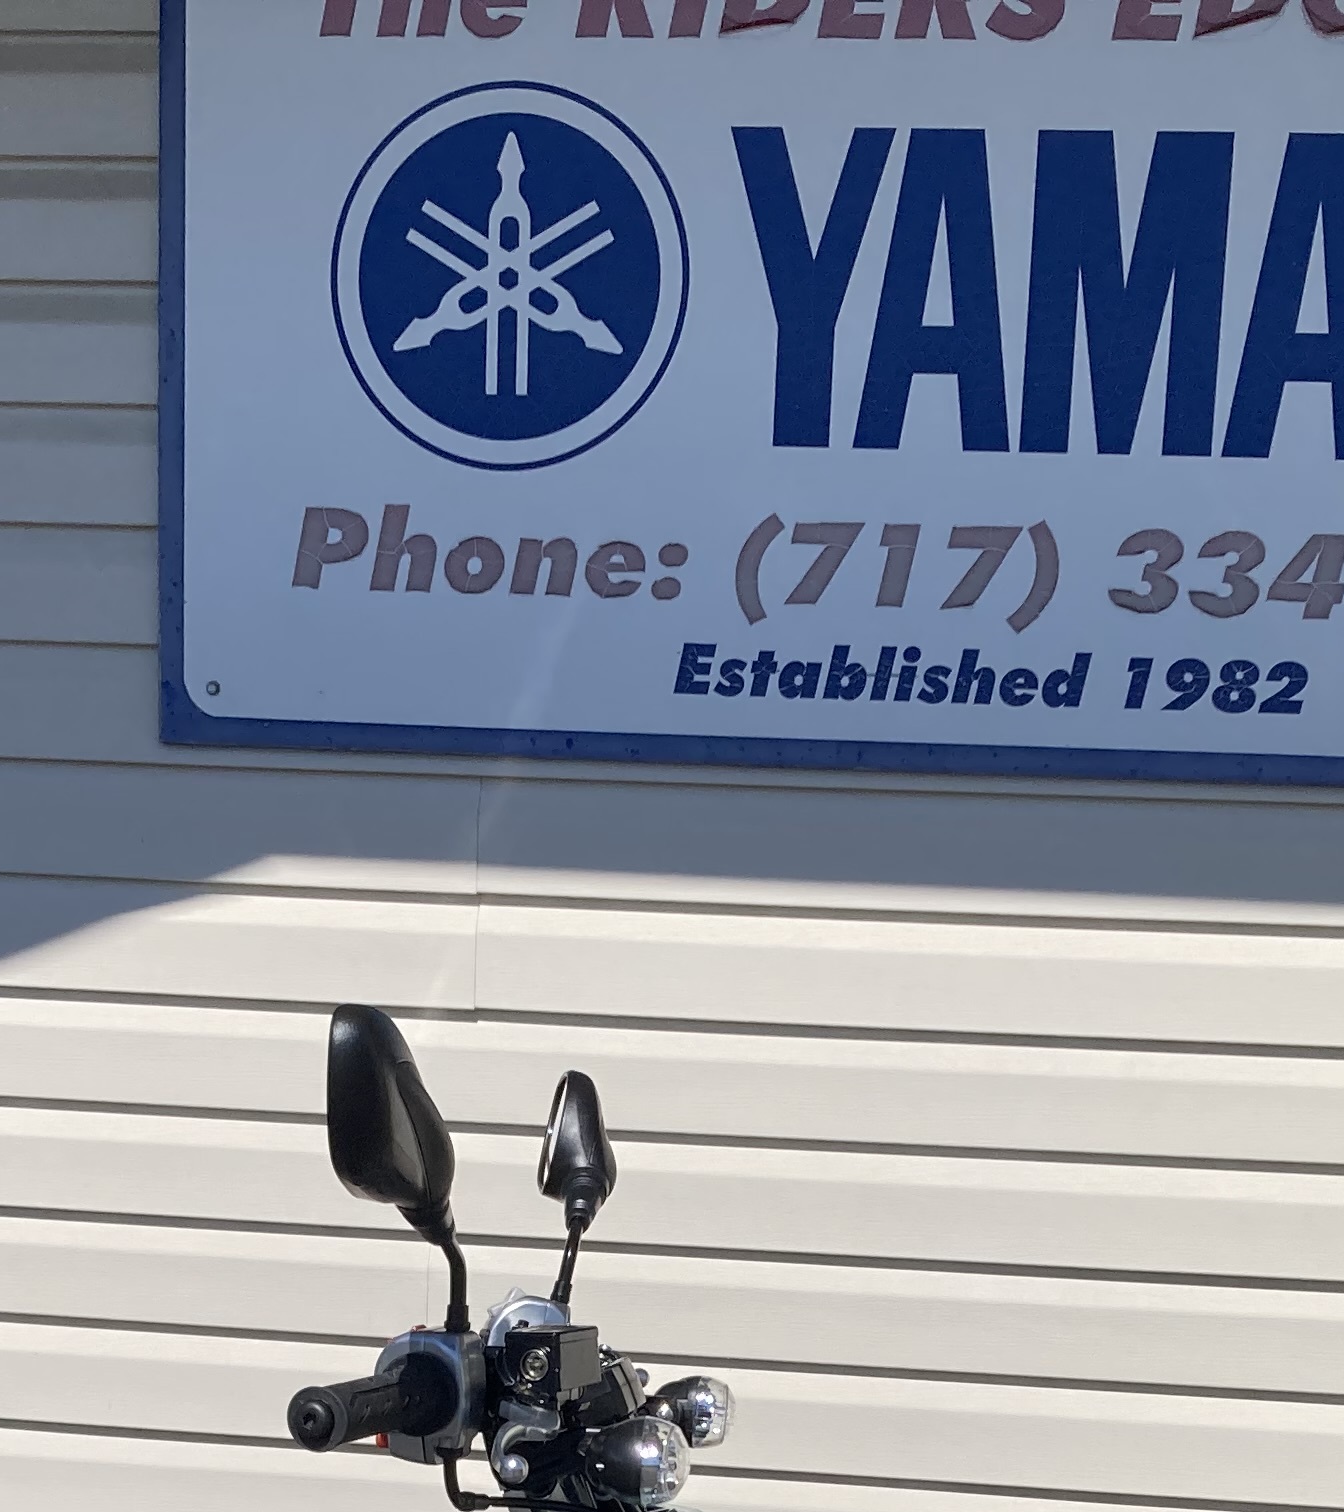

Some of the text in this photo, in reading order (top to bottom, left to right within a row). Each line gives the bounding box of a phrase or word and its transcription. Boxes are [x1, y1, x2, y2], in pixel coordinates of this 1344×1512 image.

[291, 504, 688, 600] Phone:
[735, 512, 1059, 634] (717)
[673, 643, 1308, 714] Established 1982
